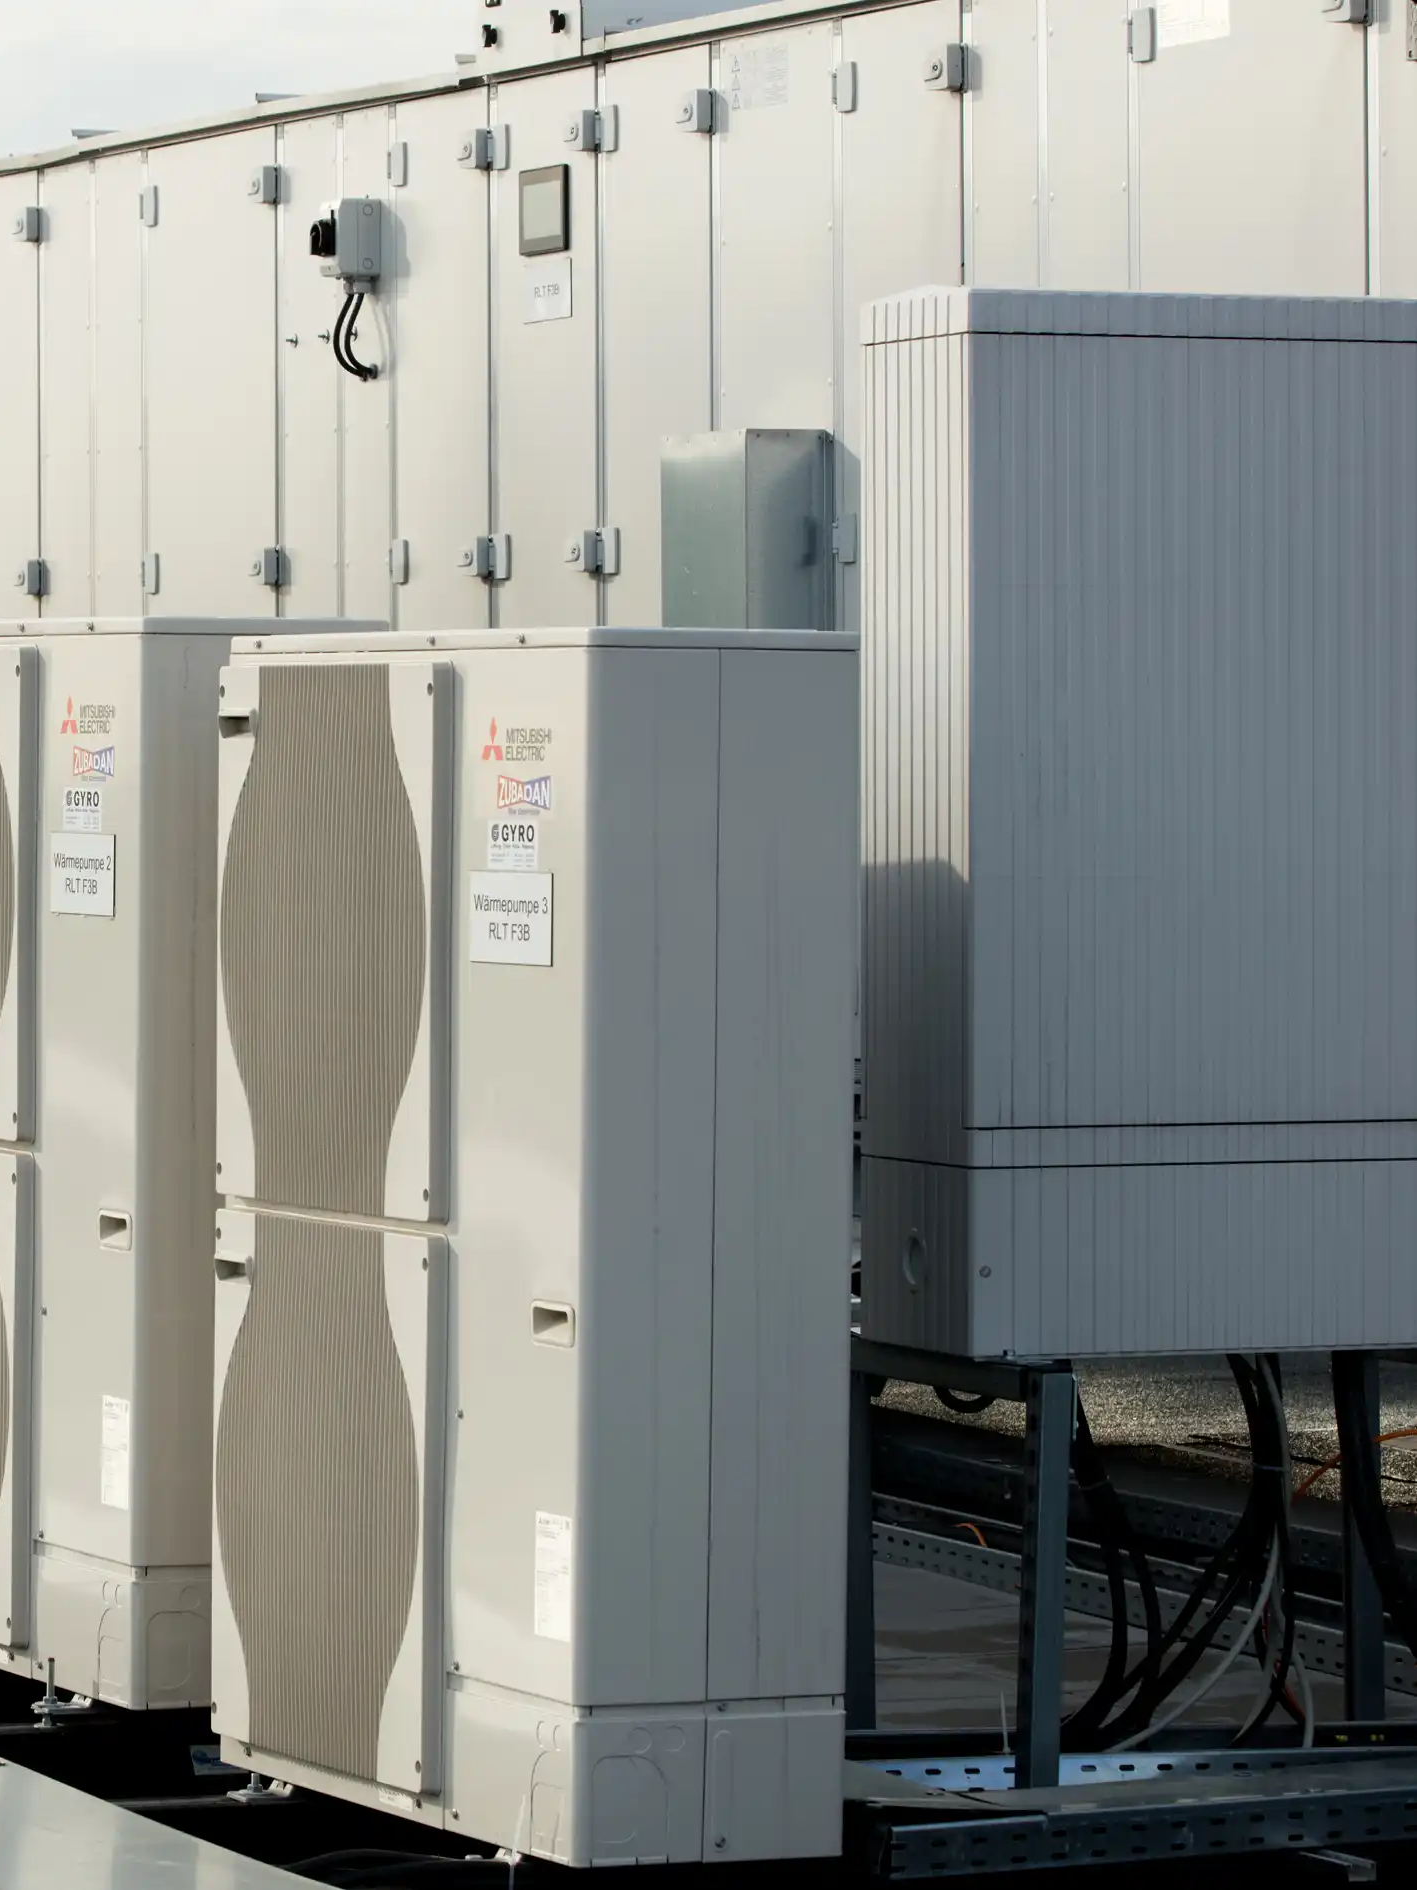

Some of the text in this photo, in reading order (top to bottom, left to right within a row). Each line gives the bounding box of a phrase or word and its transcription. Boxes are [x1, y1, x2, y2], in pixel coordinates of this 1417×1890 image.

[534, 286, 546, 298] RLT
[79, 705, 115, 719] MITSUBISHI
[79, 720, 110, 734] ELECTRIC
[506, 728, 552, 745] MITSUBISHI
[74, 748, 114, 774] ZUBADAN
[505, 745, 546, 761] ELECTRIC
[73, 791, 100, 807] GYRO
[498, 777, 550, 808] ZUBADAN
[501, 824, 535, 842] GYRO
[53, 853, 105, 874] Wärmepumpe
[65, 877, 98, 894] RLT F3B
[473, 894, 539, 918] Wärmepumpe
[489, 922, 531, 941] RLT F3B
